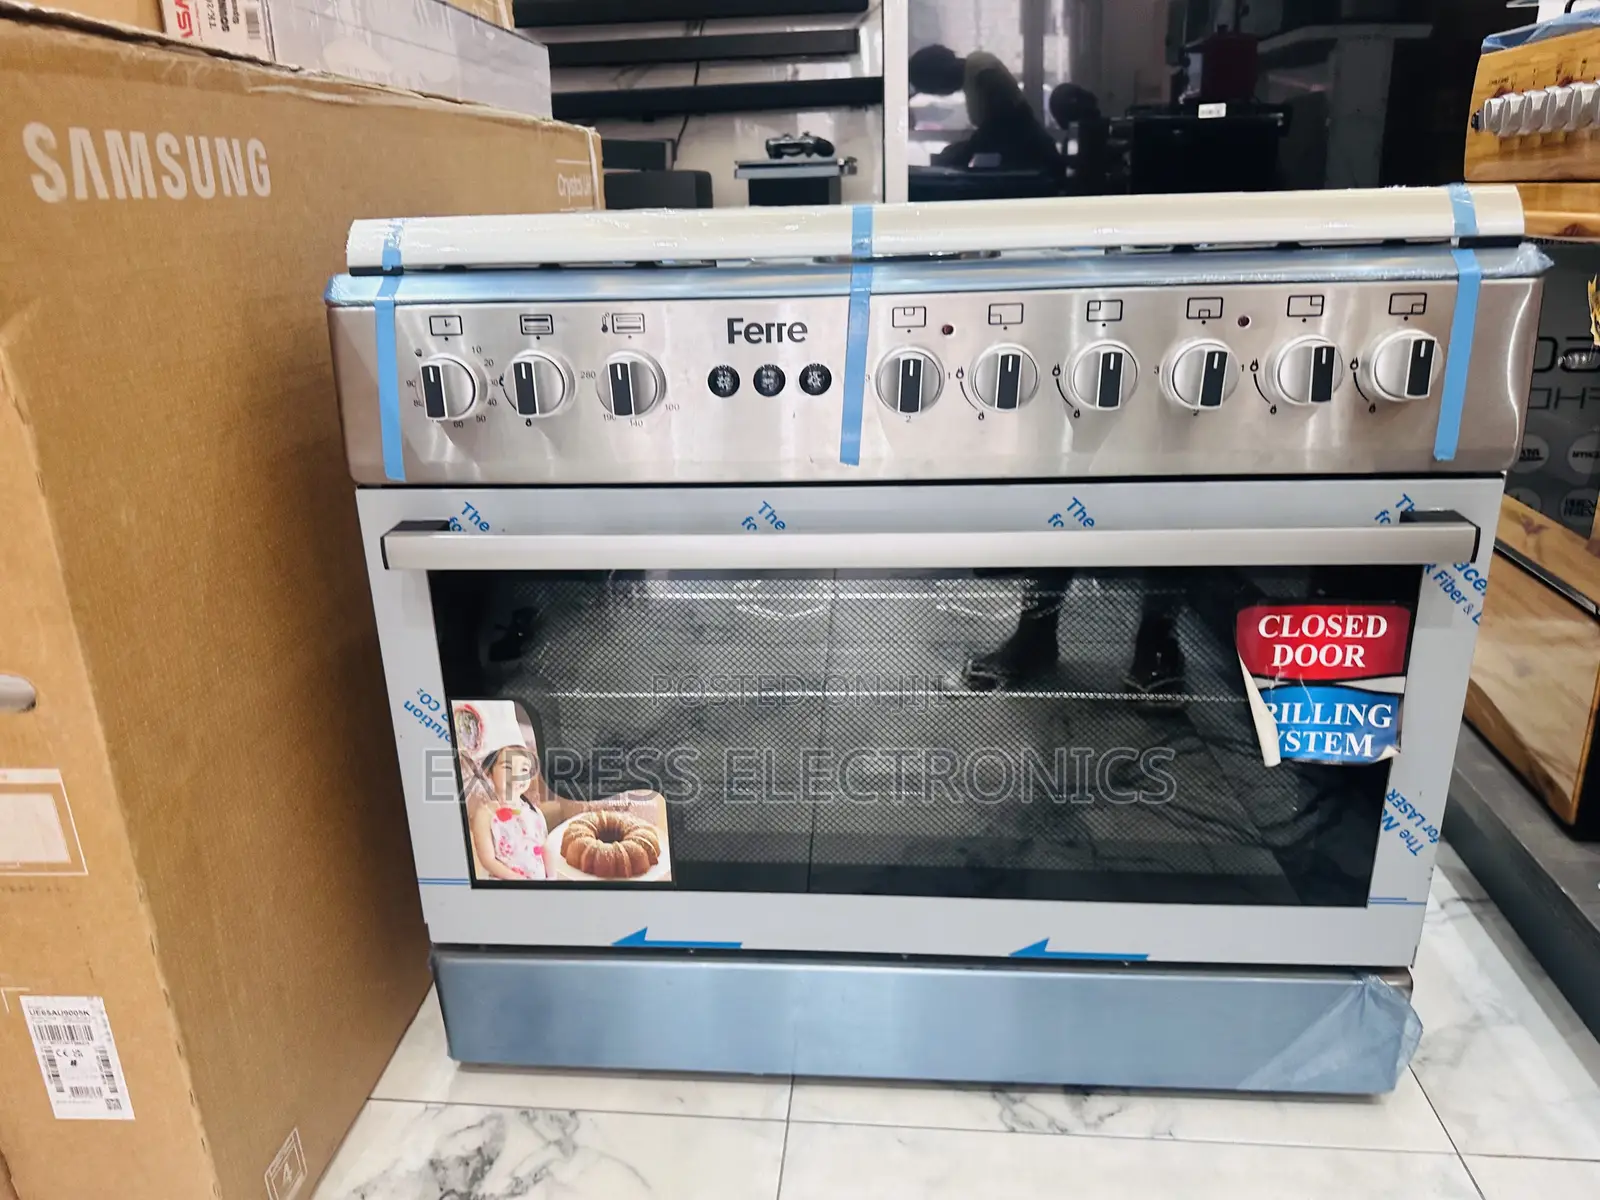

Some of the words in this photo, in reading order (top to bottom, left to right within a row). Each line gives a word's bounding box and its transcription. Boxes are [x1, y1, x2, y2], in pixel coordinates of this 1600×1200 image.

[22, 121, 271, 204] SAMSUNG
[727, 317, 808, 344] Ferre
[484, 359, 494, 367] 20
[488, 398, 498, 406] 40
[461, 500, 490, 532] The
[758, 500, 786, 530] The
[1066, 496, 1095, 528] The
[1433, 569, 1468, 605] Fiber
[1258, 614, 1388, 639] CLOSED
[1271, 643, 1366, 668] DOOR
[1386, 788, 1426, 828] LASER
[1398, 829, 1425, 857] The
